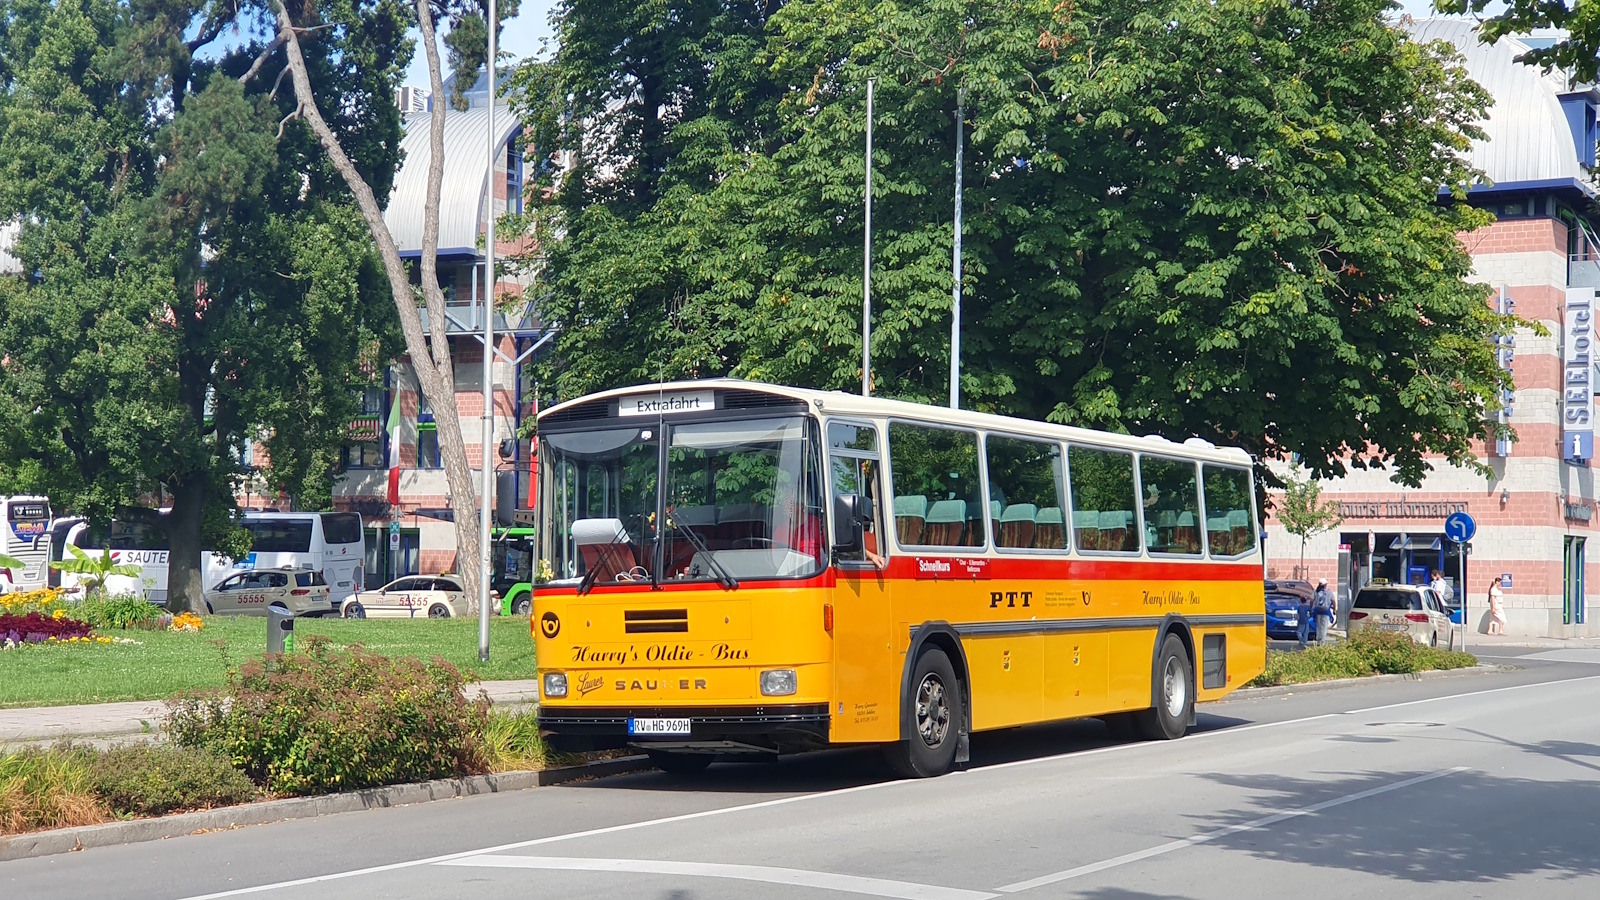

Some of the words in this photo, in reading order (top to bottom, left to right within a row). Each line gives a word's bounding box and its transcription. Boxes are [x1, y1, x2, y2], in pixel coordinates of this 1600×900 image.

[1565, 299, 1591, 425] SEEhotel
[637, 396, 700, 413] Extrafahrt
[1386, 493, 1468, 517] information
[126, 551, 170, 564] SAUTE
[919, 559, 951, 572] Schnellkurs
[237, 594, 265, 604] 55555
[399, 596, 428, 607] 55555
[989, 591, 1033, 608] PTT
[1142, 590, 1167, 608] Harry's
[1168, 590, 1184, 605] Oldie
[1387, 617, 1409, 625] 55555
[571, 645, 639, 665] Harry's
[646, 643, 694, 662] Oldie
[711, 642, 751, 661] Bus
[634, 719, 646, 732] RV
[652, 719, 664, 732] HG
[666, 718, 690, 732] 969H
